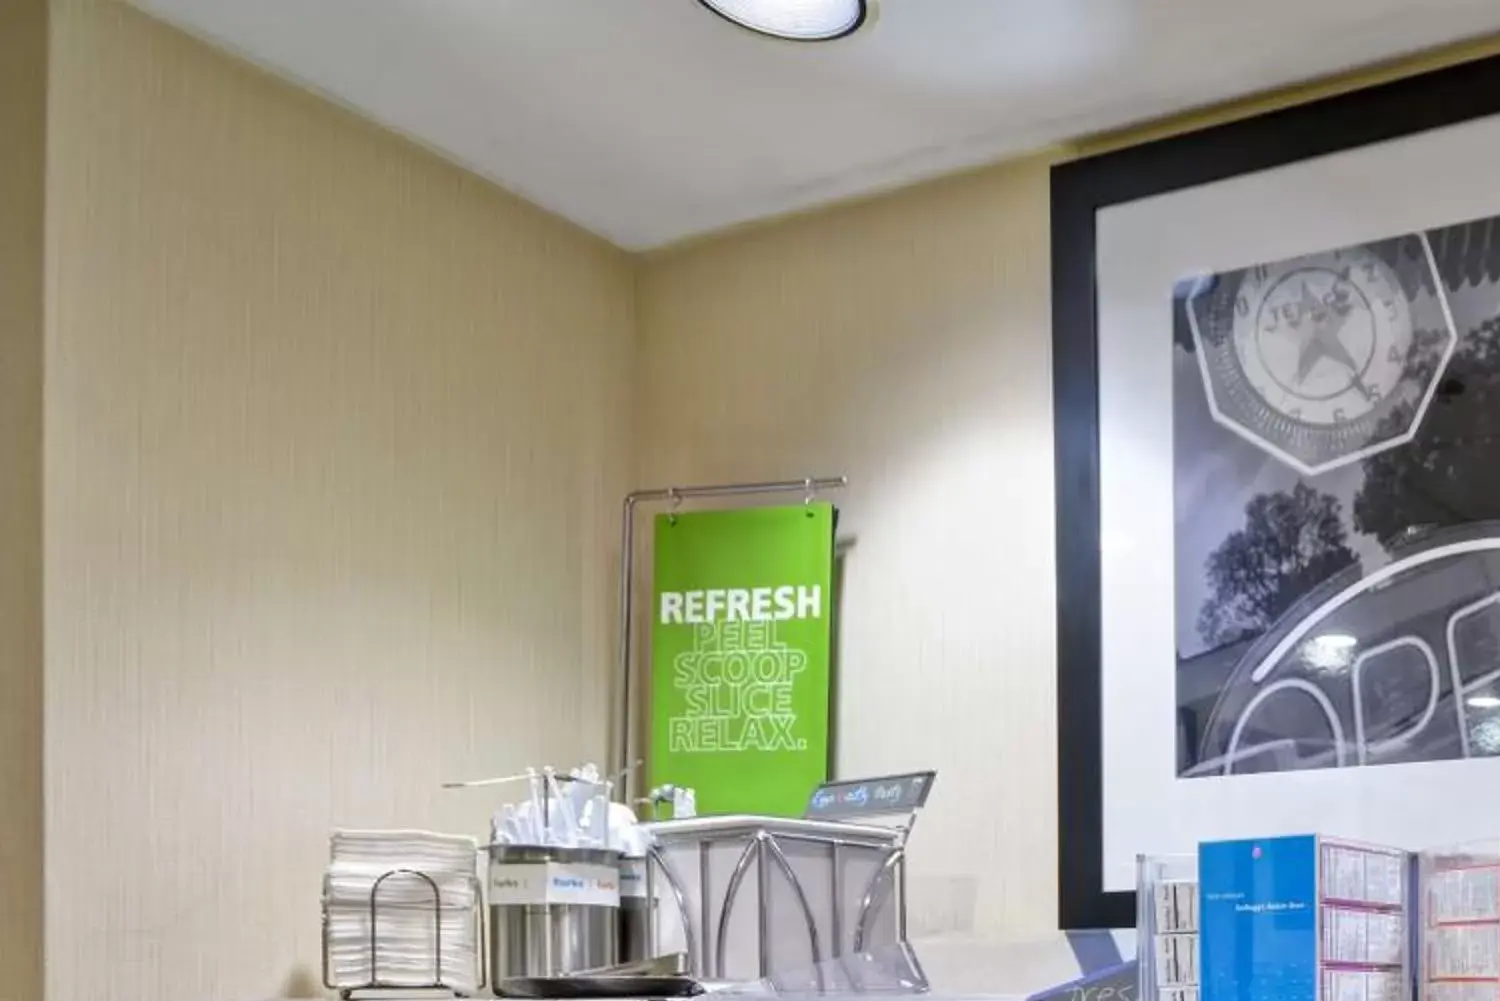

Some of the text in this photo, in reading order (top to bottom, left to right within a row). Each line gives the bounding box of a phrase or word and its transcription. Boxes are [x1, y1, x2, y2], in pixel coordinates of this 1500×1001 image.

[660, 585, 822, 625] REFRESH
[694, 619, 787, 652] PEEL
[674, 650, 807, 689] SCOOP
[686, 683, 793, 718] SLICE
[669, 714, 807, 752] RELAX.
